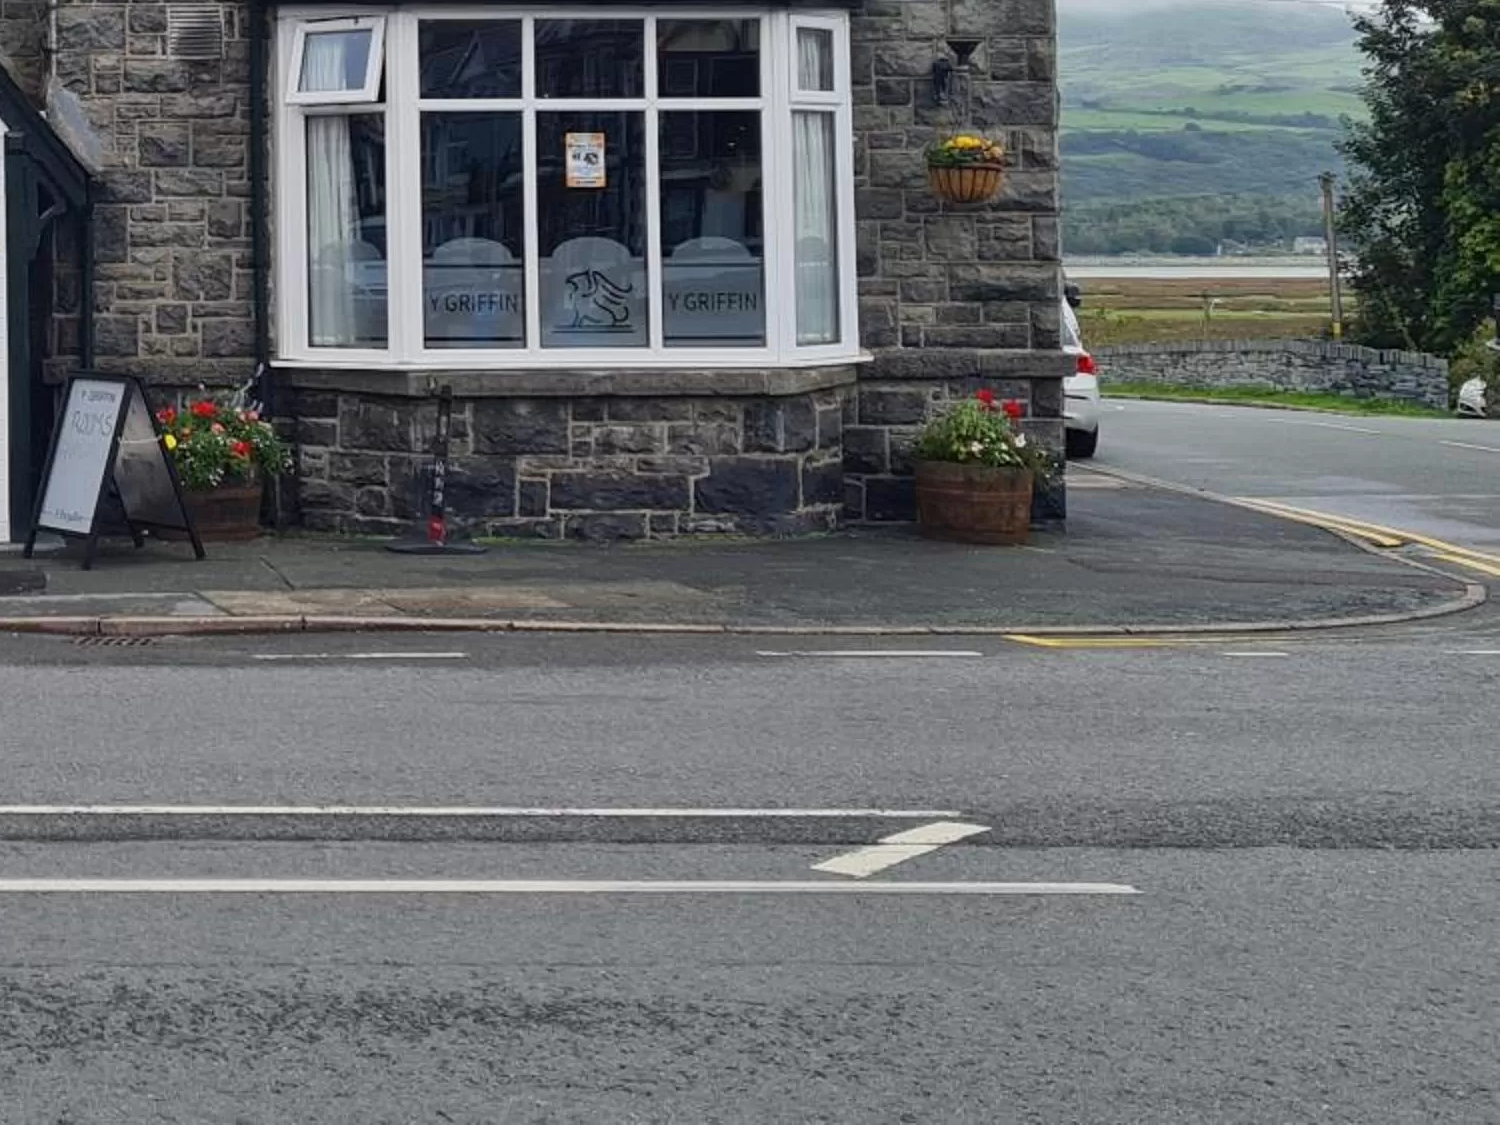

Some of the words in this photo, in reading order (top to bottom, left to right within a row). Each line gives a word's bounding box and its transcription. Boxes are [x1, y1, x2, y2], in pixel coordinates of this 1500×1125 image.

[429, 293, 439, 312] Y
[445, 293, 518, 312] GRIFFIN
[668, 293, 679, 312] Y
[684, 292, 757, 312] GRIFFIN
